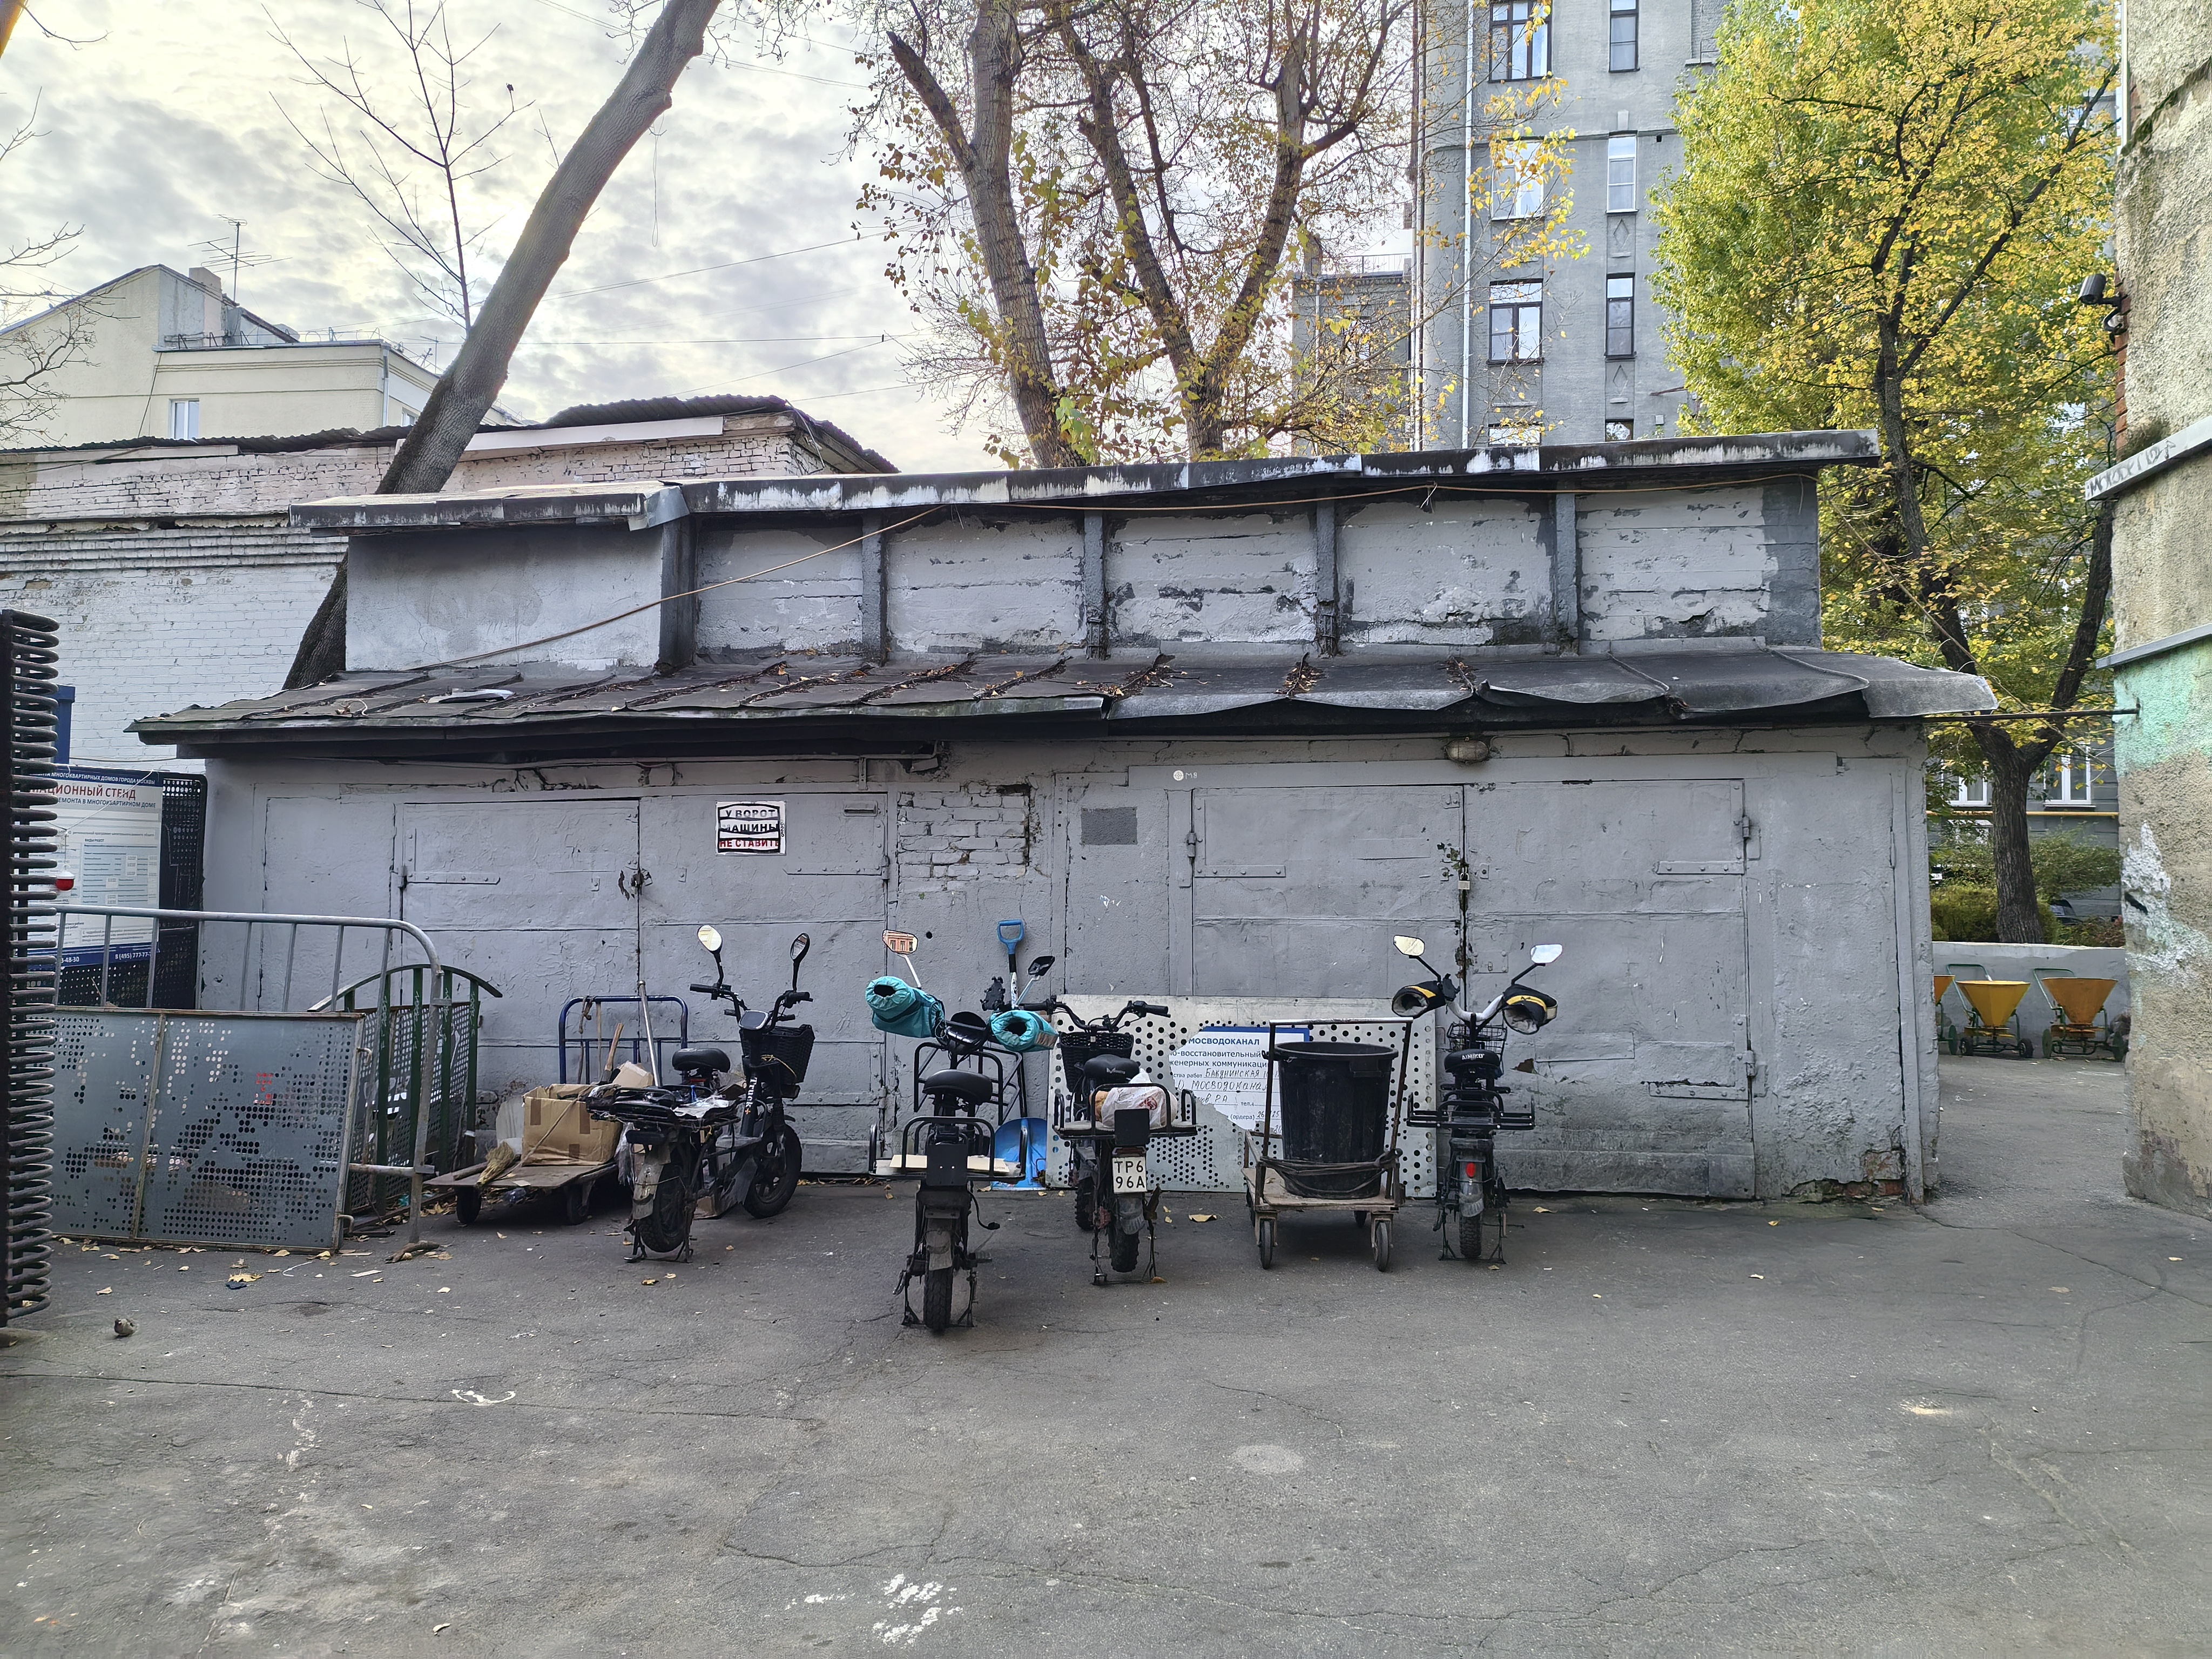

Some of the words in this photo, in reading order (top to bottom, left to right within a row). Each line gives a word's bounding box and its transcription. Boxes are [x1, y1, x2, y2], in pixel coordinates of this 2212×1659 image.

[105, 788, 136, 801] СТЕНД
[735, 810, 775, 818] ВОРОТ
[119, 952, 132, 960] (495)
